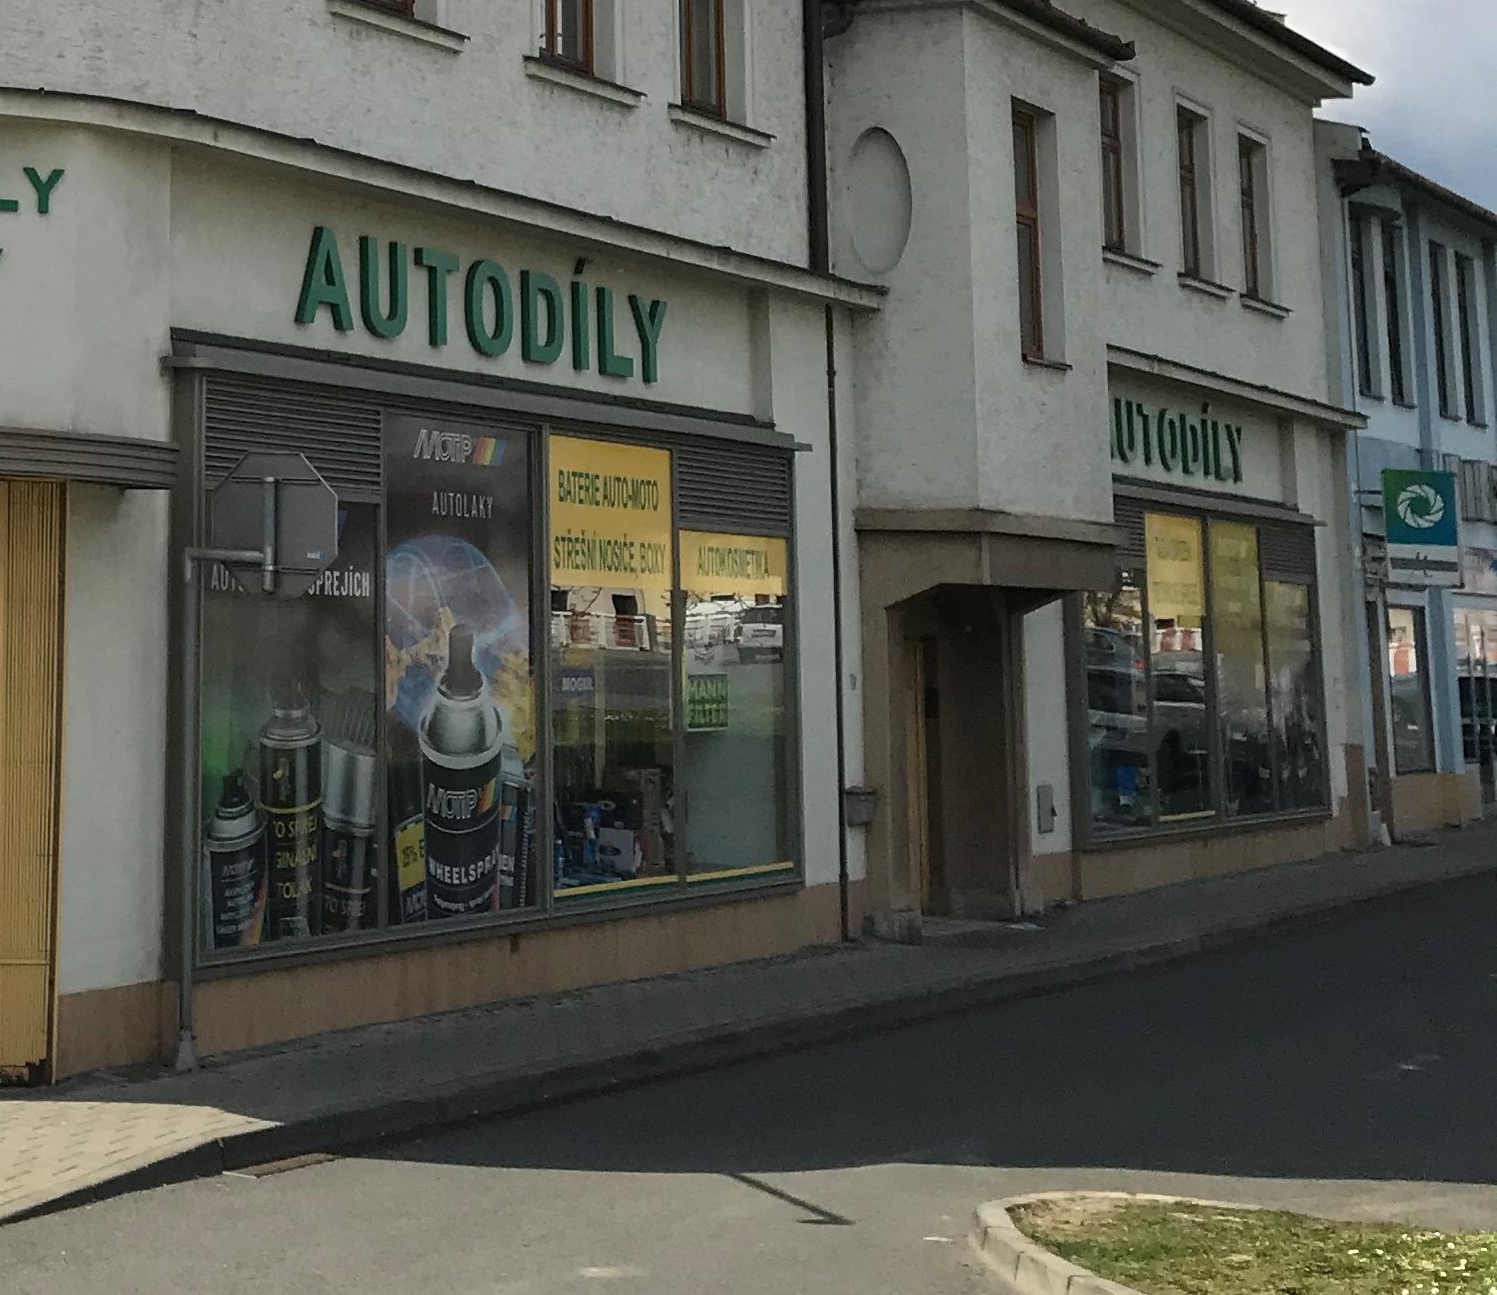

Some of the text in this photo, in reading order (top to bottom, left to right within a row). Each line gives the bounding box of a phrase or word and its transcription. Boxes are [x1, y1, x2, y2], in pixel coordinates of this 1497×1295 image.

[295, 226, 668, 384] AUTODÍLY
[413, 429, 472, 464] MOTIP
[432, 491, 493, 519] AUTOLAKY
[558, 469, 659, 512] BATERIE AUTO-MOTO
[554, 528, 666, 577] STŘEŠNÍ NOSIČE, BOXY
[697, 545, 770, 579] AUTOKOSMETIKA
[561, 676, 594, 692] MOGUL
